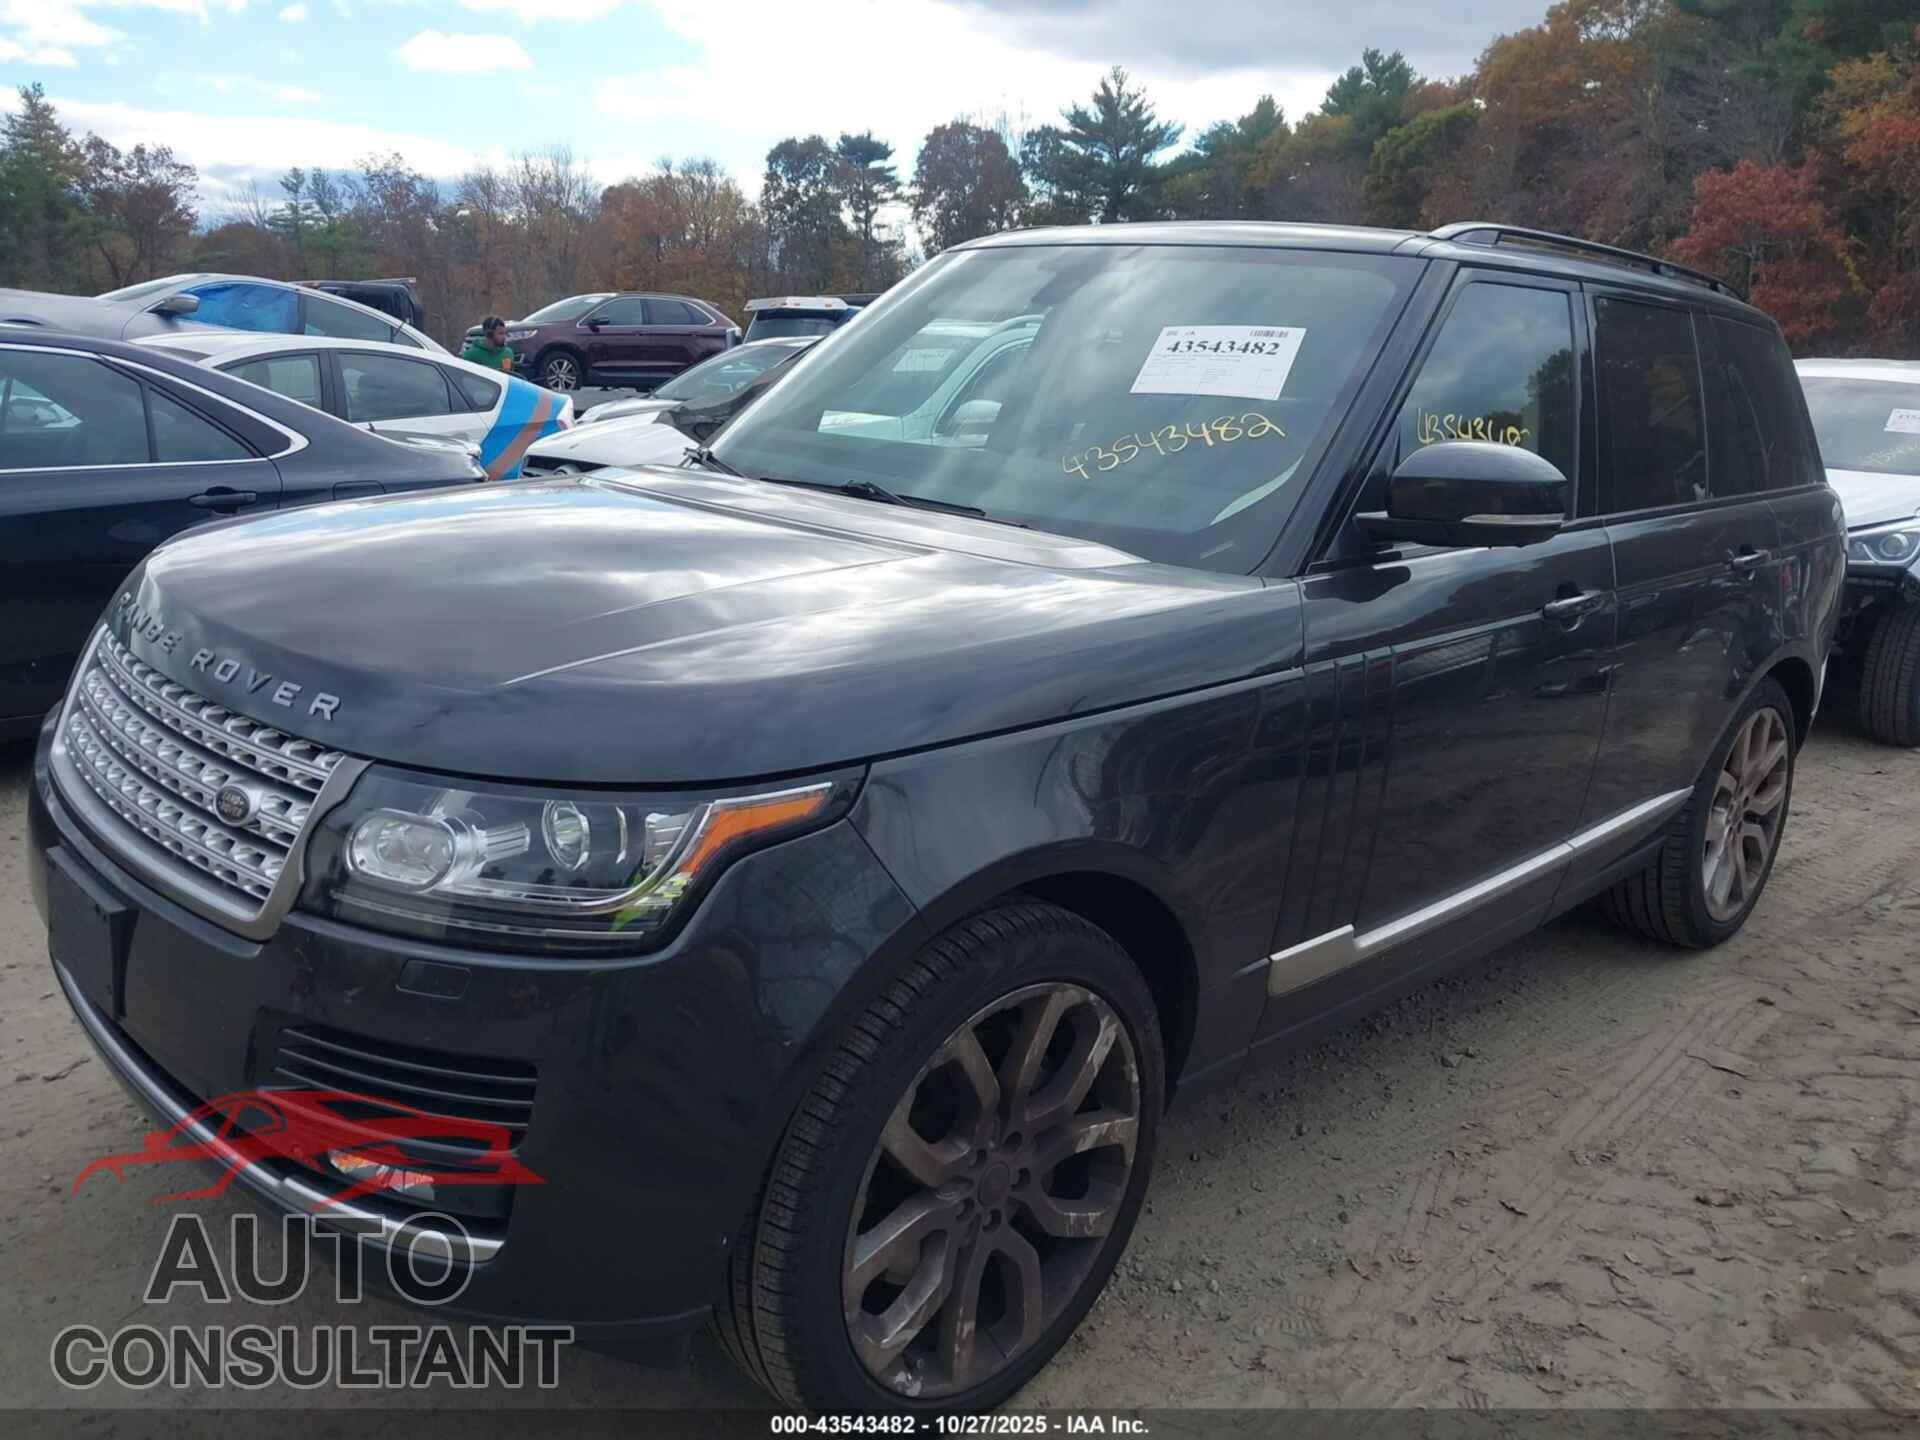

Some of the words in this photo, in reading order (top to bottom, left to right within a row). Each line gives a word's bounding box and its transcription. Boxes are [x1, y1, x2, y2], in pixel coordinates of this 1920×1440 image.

[1166, 340, 1280, 356] 43543482
[1061, 412, 1286, 480] 43543482
[118, 591, 183, 655] RANGE
[189, 647, 342, 721] ROVER
